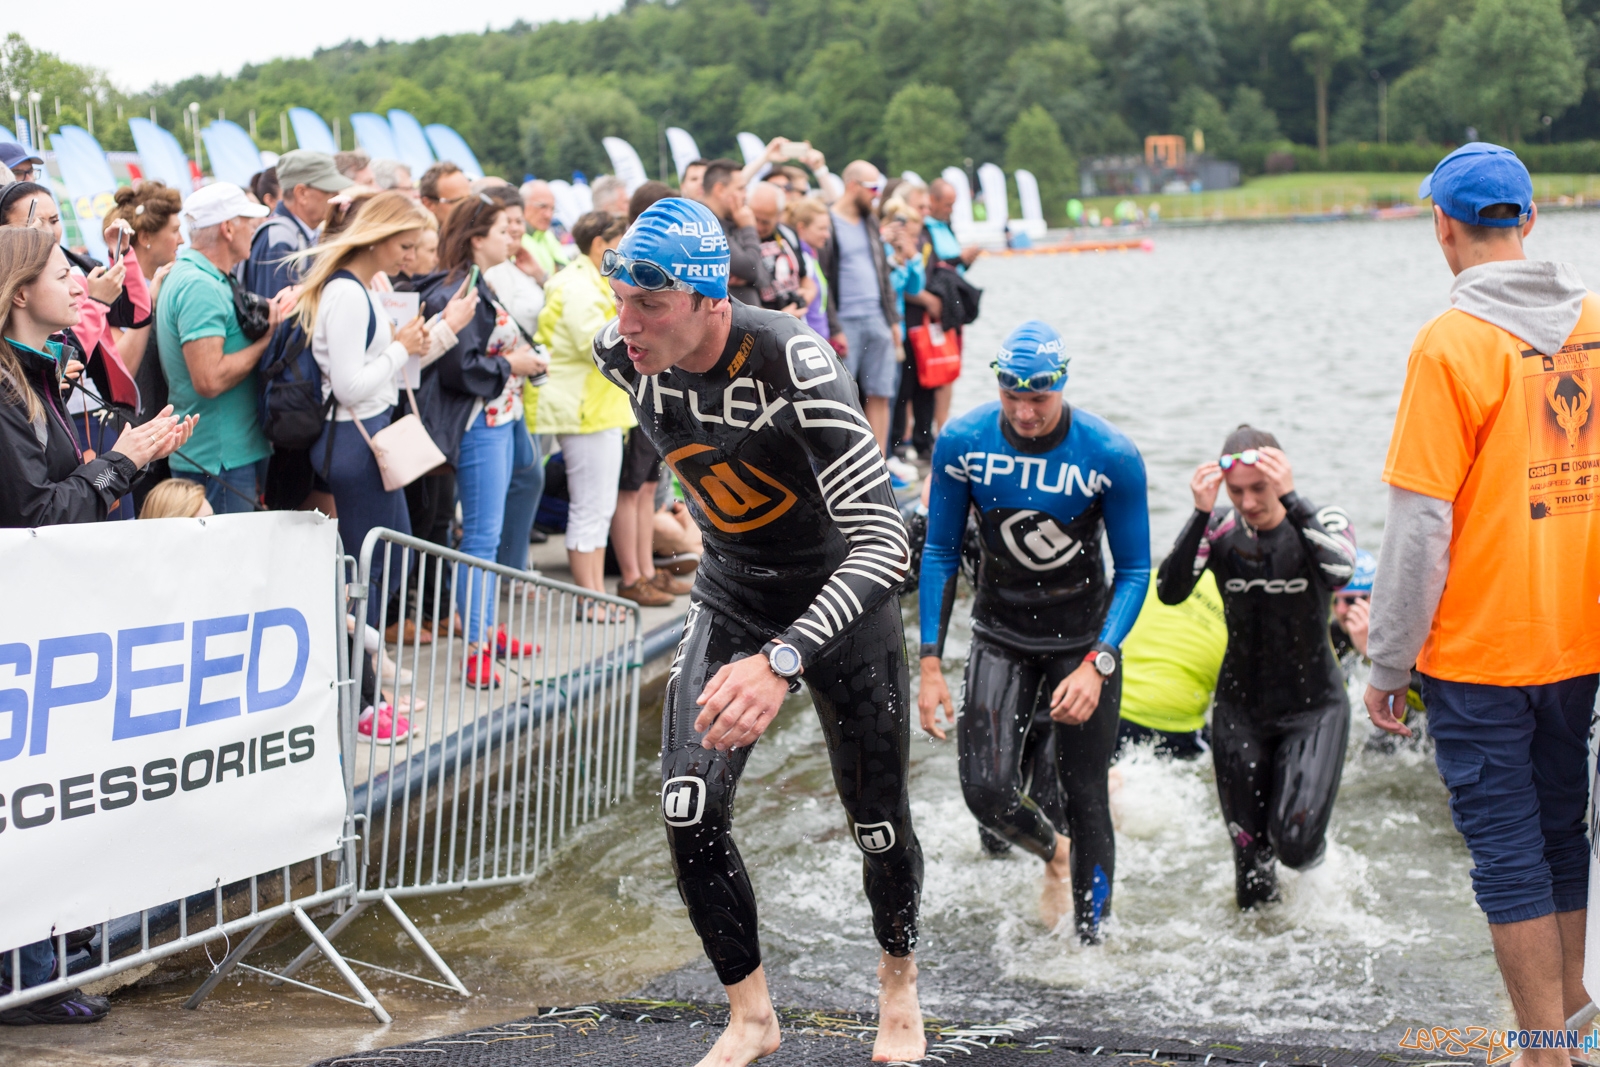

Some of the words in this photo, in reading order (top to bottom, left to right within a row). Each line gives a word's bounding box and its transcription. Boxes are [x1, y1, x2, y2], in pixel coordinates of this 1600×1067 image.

[665, 221, 722, 238] AQUA
[1575, 475, 1591, 485] 4F
[1225, 578, 1308, 593] orca
[0, 725, 315, 835] CESSORIES
